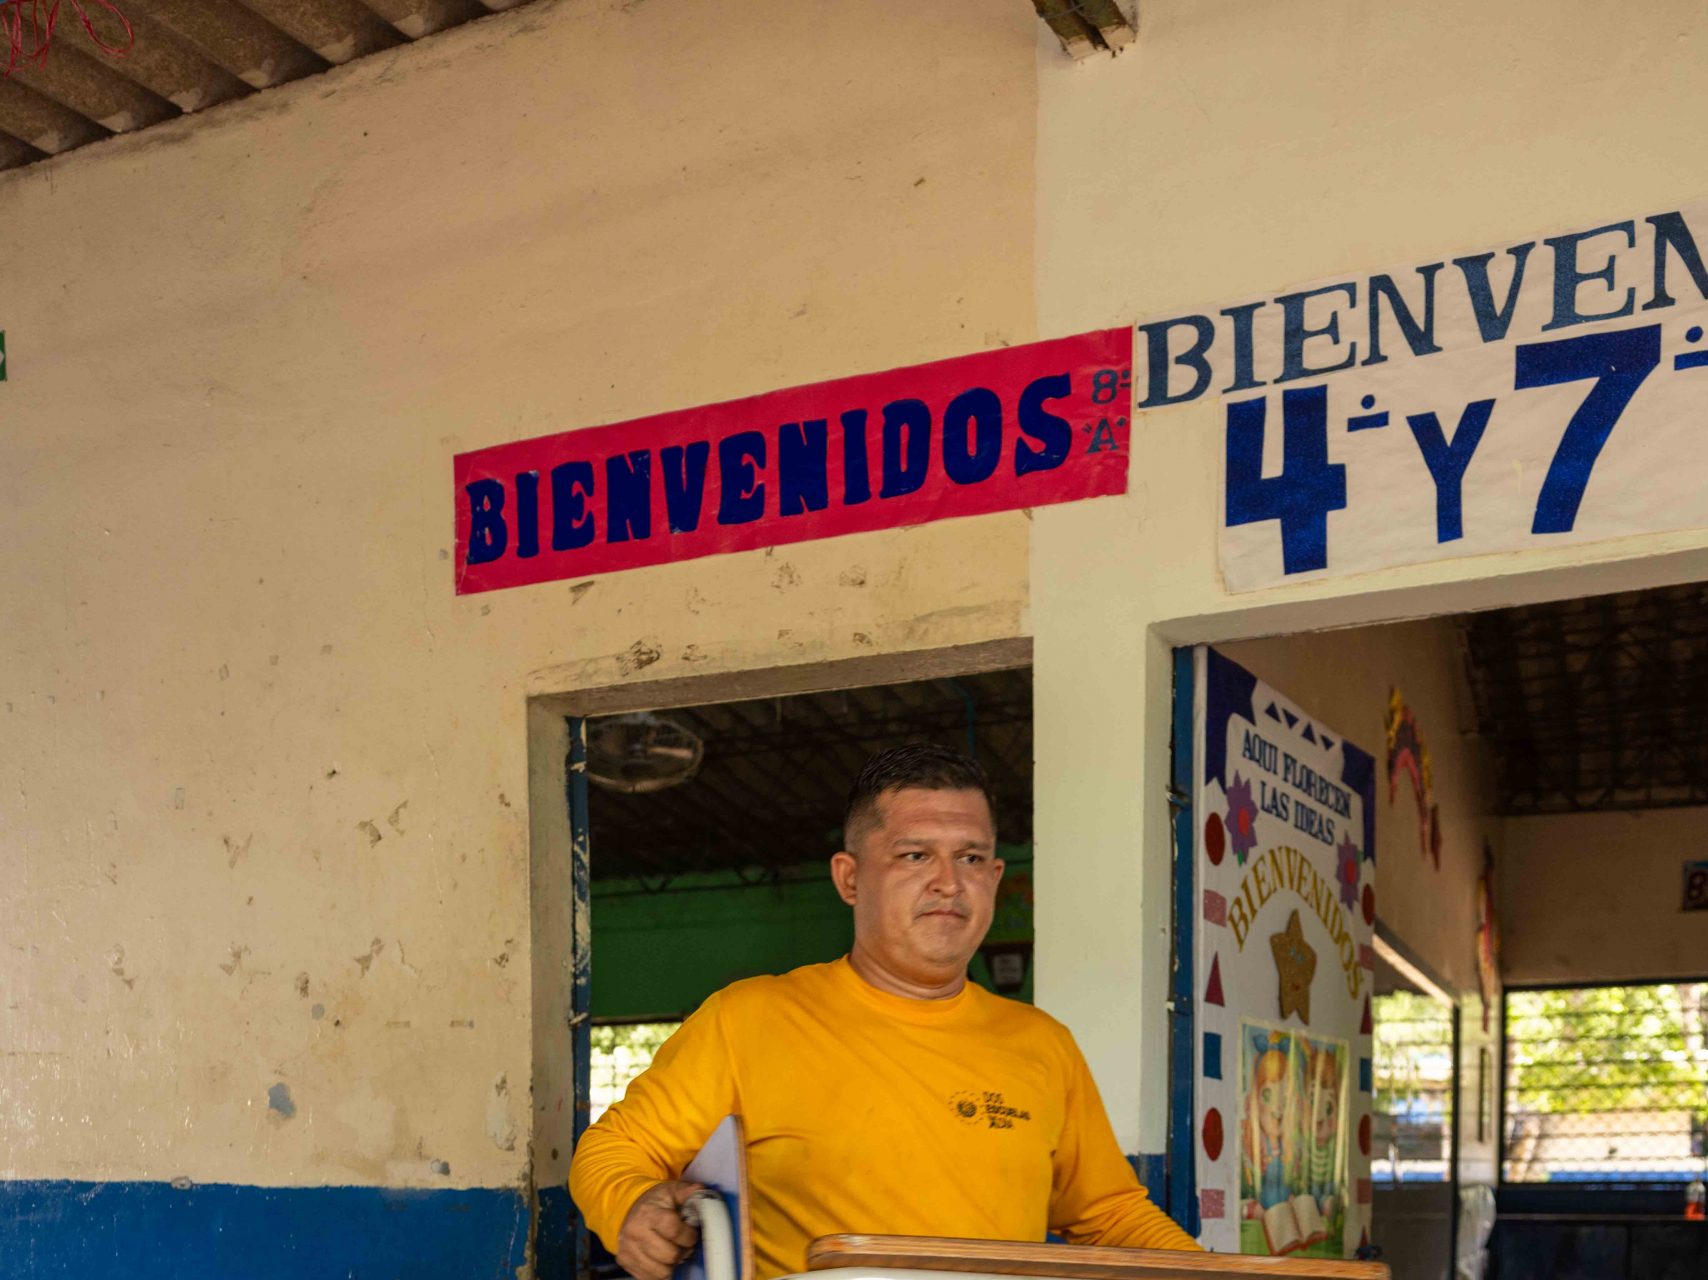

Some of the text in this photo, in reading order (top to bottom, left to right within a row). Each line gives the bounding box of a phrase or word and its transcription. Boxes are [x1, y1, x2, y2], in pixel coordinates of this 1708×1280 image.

[1138, 211, 1708, 409] BIENVEN
[465, 372, 1072, 565] BIENVENIDOS
[1406, 398, 1497, 544] Y
[1242, 728, 1351, 820] AQUI FLORECEN
[1260, 780, 1335, 846] LAS IDEAS
[1227, 845, 1364, 1001] BIENVENIDOS
